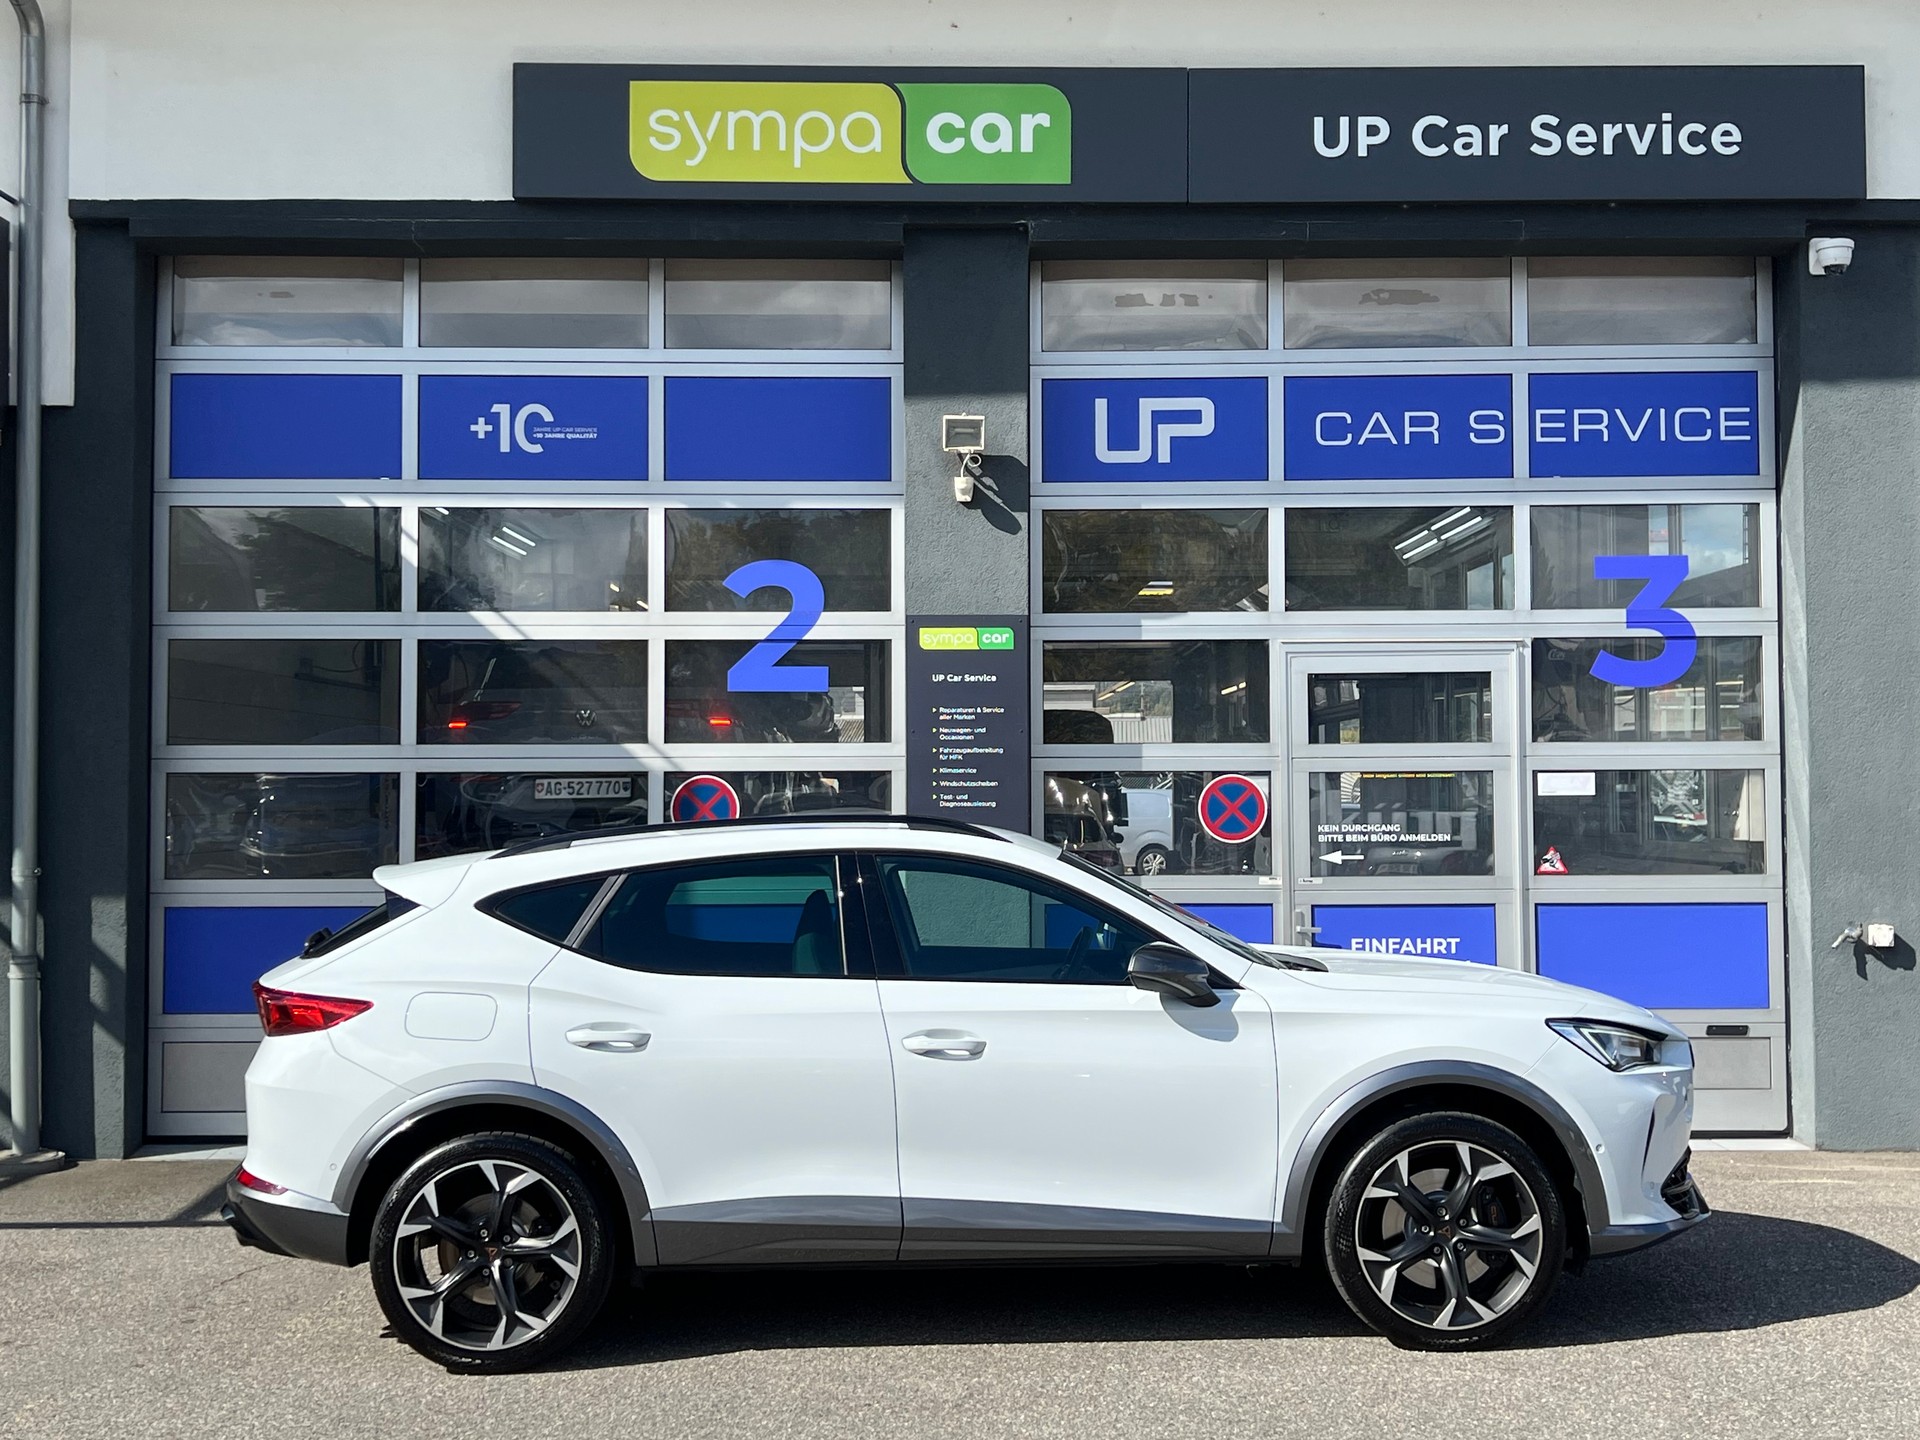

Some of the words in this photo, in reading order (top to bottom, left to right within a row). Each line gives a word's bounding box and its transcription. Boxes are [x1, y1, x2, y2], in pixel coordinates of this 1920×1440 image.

[648, 108, 882, 168] sympa
[925, 111, 1051, 154] car
[1313, 115, 1391, 157] UP
[1411, 115, 1509, 157] Car
[1529, 112, 1743, 156] Service
[566, 432, 598, 440] QUALITÄT
[1094, 397, 1215, 463] UP
[1314, 411, 1440, 446] CAR
[1468, 407, 1752, 445] SERVICE
[722, 559, 830, 692] 2
[1589, 555, 1698, 688] 3
[923, 633, 975, 647] sympa
[982, 633, 1010, 644] car
[932, 674, 945, 682] UP
[946, 674, 962, 682] Car
[964, 673, 997, 682] Service
[1317, 824, 1339, 832] KEIN
[1341, 824, 1401, 832] DURCHGANG
[1318, 834, 1344, 842] BITTE
[1345, 834, 1369, 842] BEIM
[1370, 832, 1397, 842] BÜRO
[1398, 833, 1451, 842] ANMELDEN
